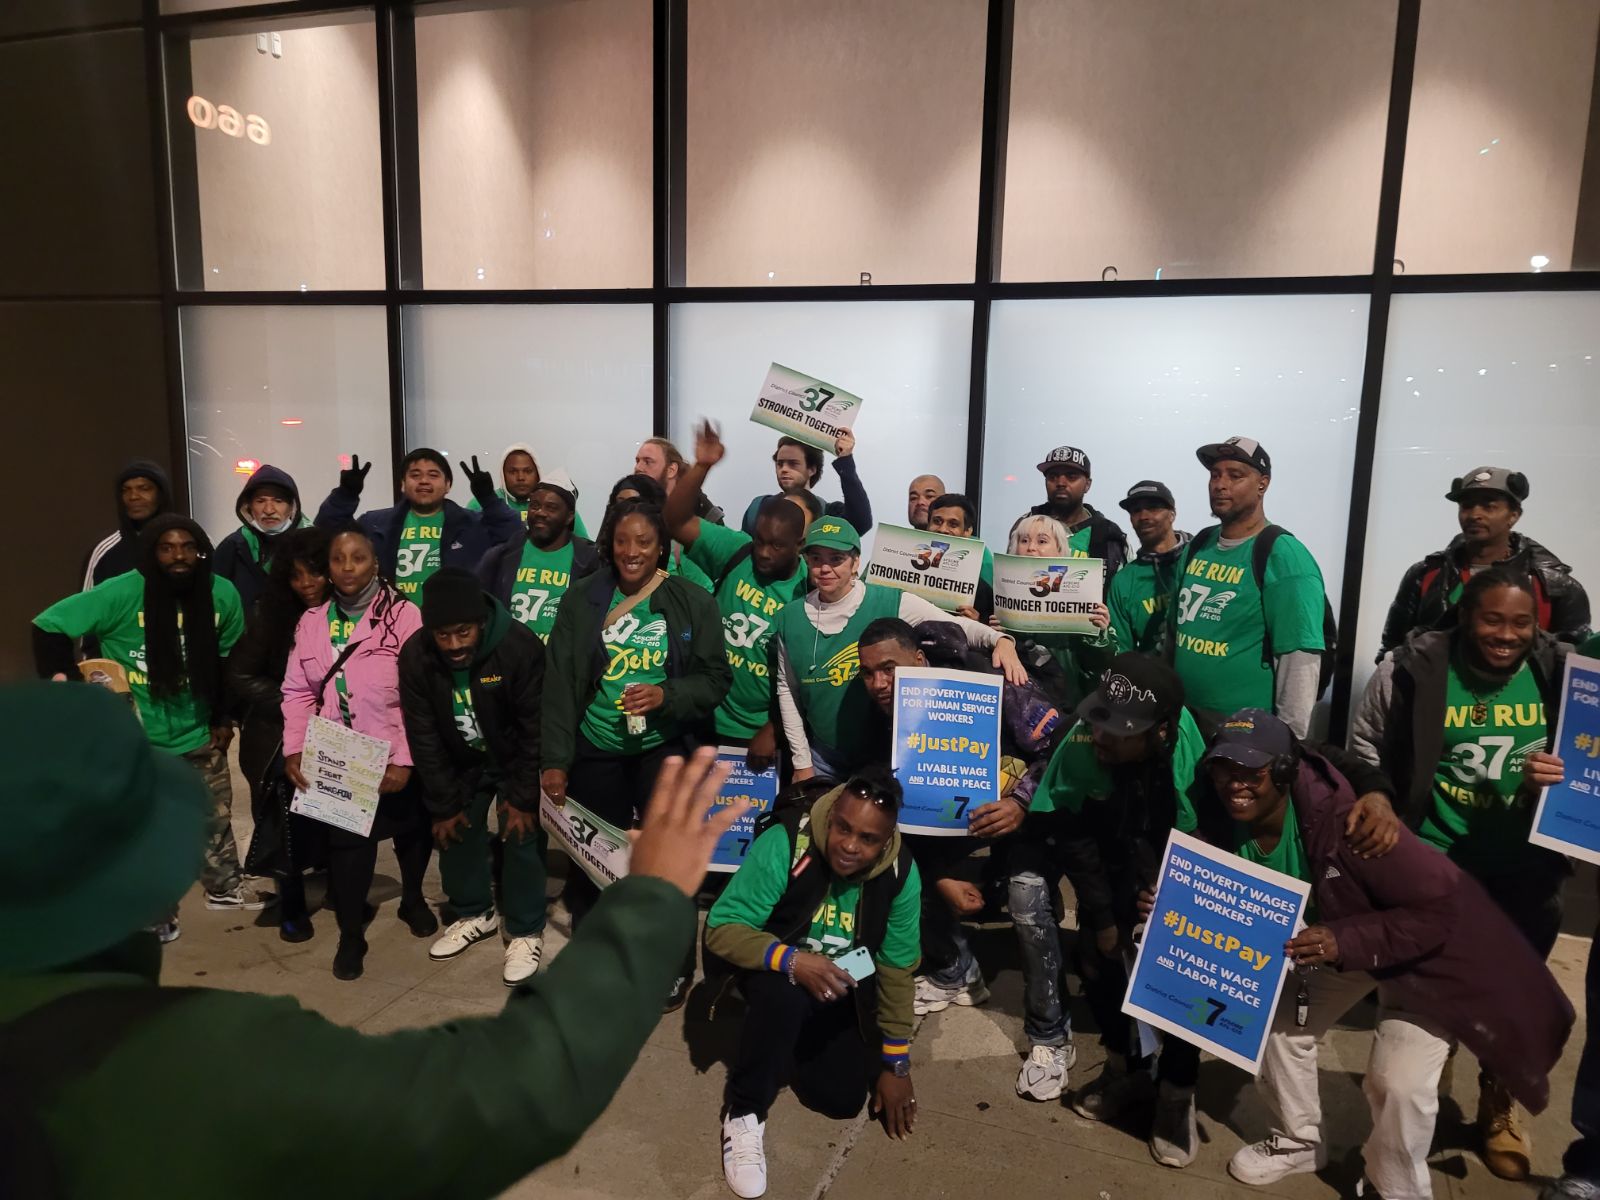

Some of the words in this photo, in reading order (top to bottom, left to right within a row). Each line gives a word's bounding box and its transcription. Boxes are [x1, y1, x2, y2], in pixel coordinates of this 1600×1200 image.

[758, 397, 804, 422] STRONGER
[799, 387, 835, 412] 37
[1072, 450, 1087, 466] BK
[419, 526, 443, 539] RU
[395, 543, 431, 578] 37
[911, 541, 950, 571] 37
[869, 563, 921, 585] STRONGER
[923, 574, 975, 595] TOGETHER
[1029, 565, 1068, 598] 37
[1205, 562, 1245, 585] RUN
[510, 588, 550, 624] 37
[735, 579, 765, 608] WE
[994, 594, 1042, 613] STRONGER
[1177, 583, 1212, 625] 37
[721, 616, 733, 628] DC
[724, 612, 770, 649] 37
[129, 650, 146, 659] DC
[1187, 635, 1229, 657] YORK
[747, 660, 770, 677] YO
[828, 663, 853, 687] 37
[901, 687, 921, 696] END
[922, 687, 966, 700] POVERTY
[966, 691, 998, 704] WAGES
[1572, 678, 1599, 692] END
[902, 699, 922, 708] FOR
[924, 700, 960, 711] HUMAN
[962, 703, 995, 715] SERVICE
[1573, 691, 1599, 708] FOR
[928, 711, 974, 724] WORKERS
[317, 750, 346, 767] STAND
[906, 732, 990, 760] #JustPay
[917, 763, 957, 775] LIVABLE
[959, 766, 988, 777] WAGE
[1450, 735, 1515, 784] 37
[723, 777, 754, 786] ORKERS
[908, 776, 925, 785] AND
[926, 776, 959, 788] LABOR
[962, 779, 992, 790] PEACE
[1569, 780, 1591, 794] AND
[568, 815, 599, 847] 37
[580, 847, 620, 882] TOGETHE
[1170, 854, 1192, 872] END
[1193, 864, 1248, 895] POVERTY
[1250, 887, 1297, 914] WAGES
[1168, 868, 1191, 887] FOR
[1192, 878, 1237, 906] HUMAN
[1238, 898, 1290, 927] SERVICE
[1193, 894, 1254, 927] WORKERS
[1163, 910, 1272, 971] #JustPay
[1169, 944, 1218, 974] LIVABLE
[1220, 967, 1260, 992] WAGE
[1157, 955, 1175, 970] AND
[1177, 963, 1217, 990] LABOR
[1220, 983, 1261, 1009] PEACE
[1187, 997, 1227, 1027] 37
